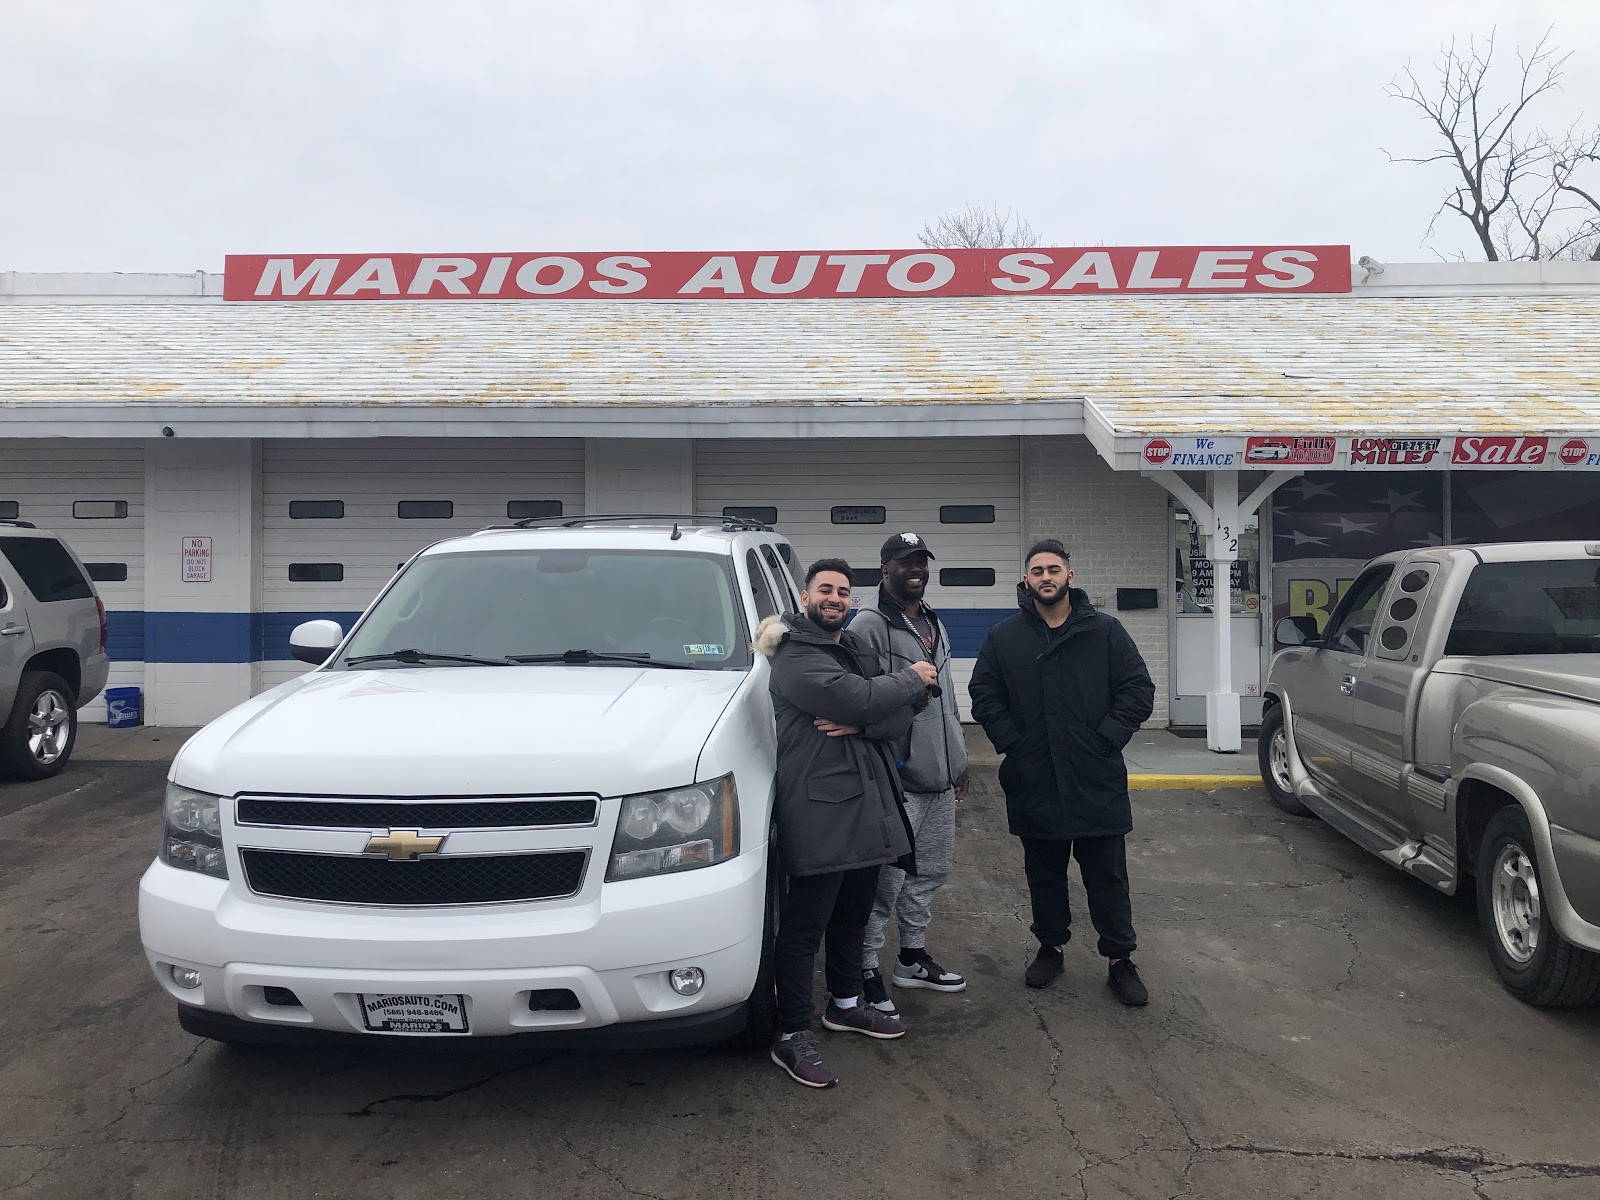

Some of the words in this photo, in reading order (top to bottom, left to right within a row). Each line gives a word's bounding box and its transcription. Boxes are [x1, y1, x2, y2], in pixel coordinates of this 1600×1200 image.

[254, 256, 652, 296] MARIOS
[677, 253, 956, 294] AUTO
[991, 249, 1319, 291] SALES
[1196, 439, 1215, 449] We
[1293, 437, 1335, 451] Fully
[1351, 438, 1394, 451] LOW
[1454, 437, 1543, 463] Sale
[1146, 447, 1170, 457] STOP
[1290, 449, 1333, 462] LOADED
[1350, 450, 1439, 465] MILES
[1561, 447, 1586, 457] STOP
[1172, 453, 1234, 465] FINANCE
[191, 539, 203, 548] NO
[184, 549, 210, 557] PARKING
[1199, 569, 1213, 577] AM
[366, 995, 459, 1015] MARIOSAUTO.COM
